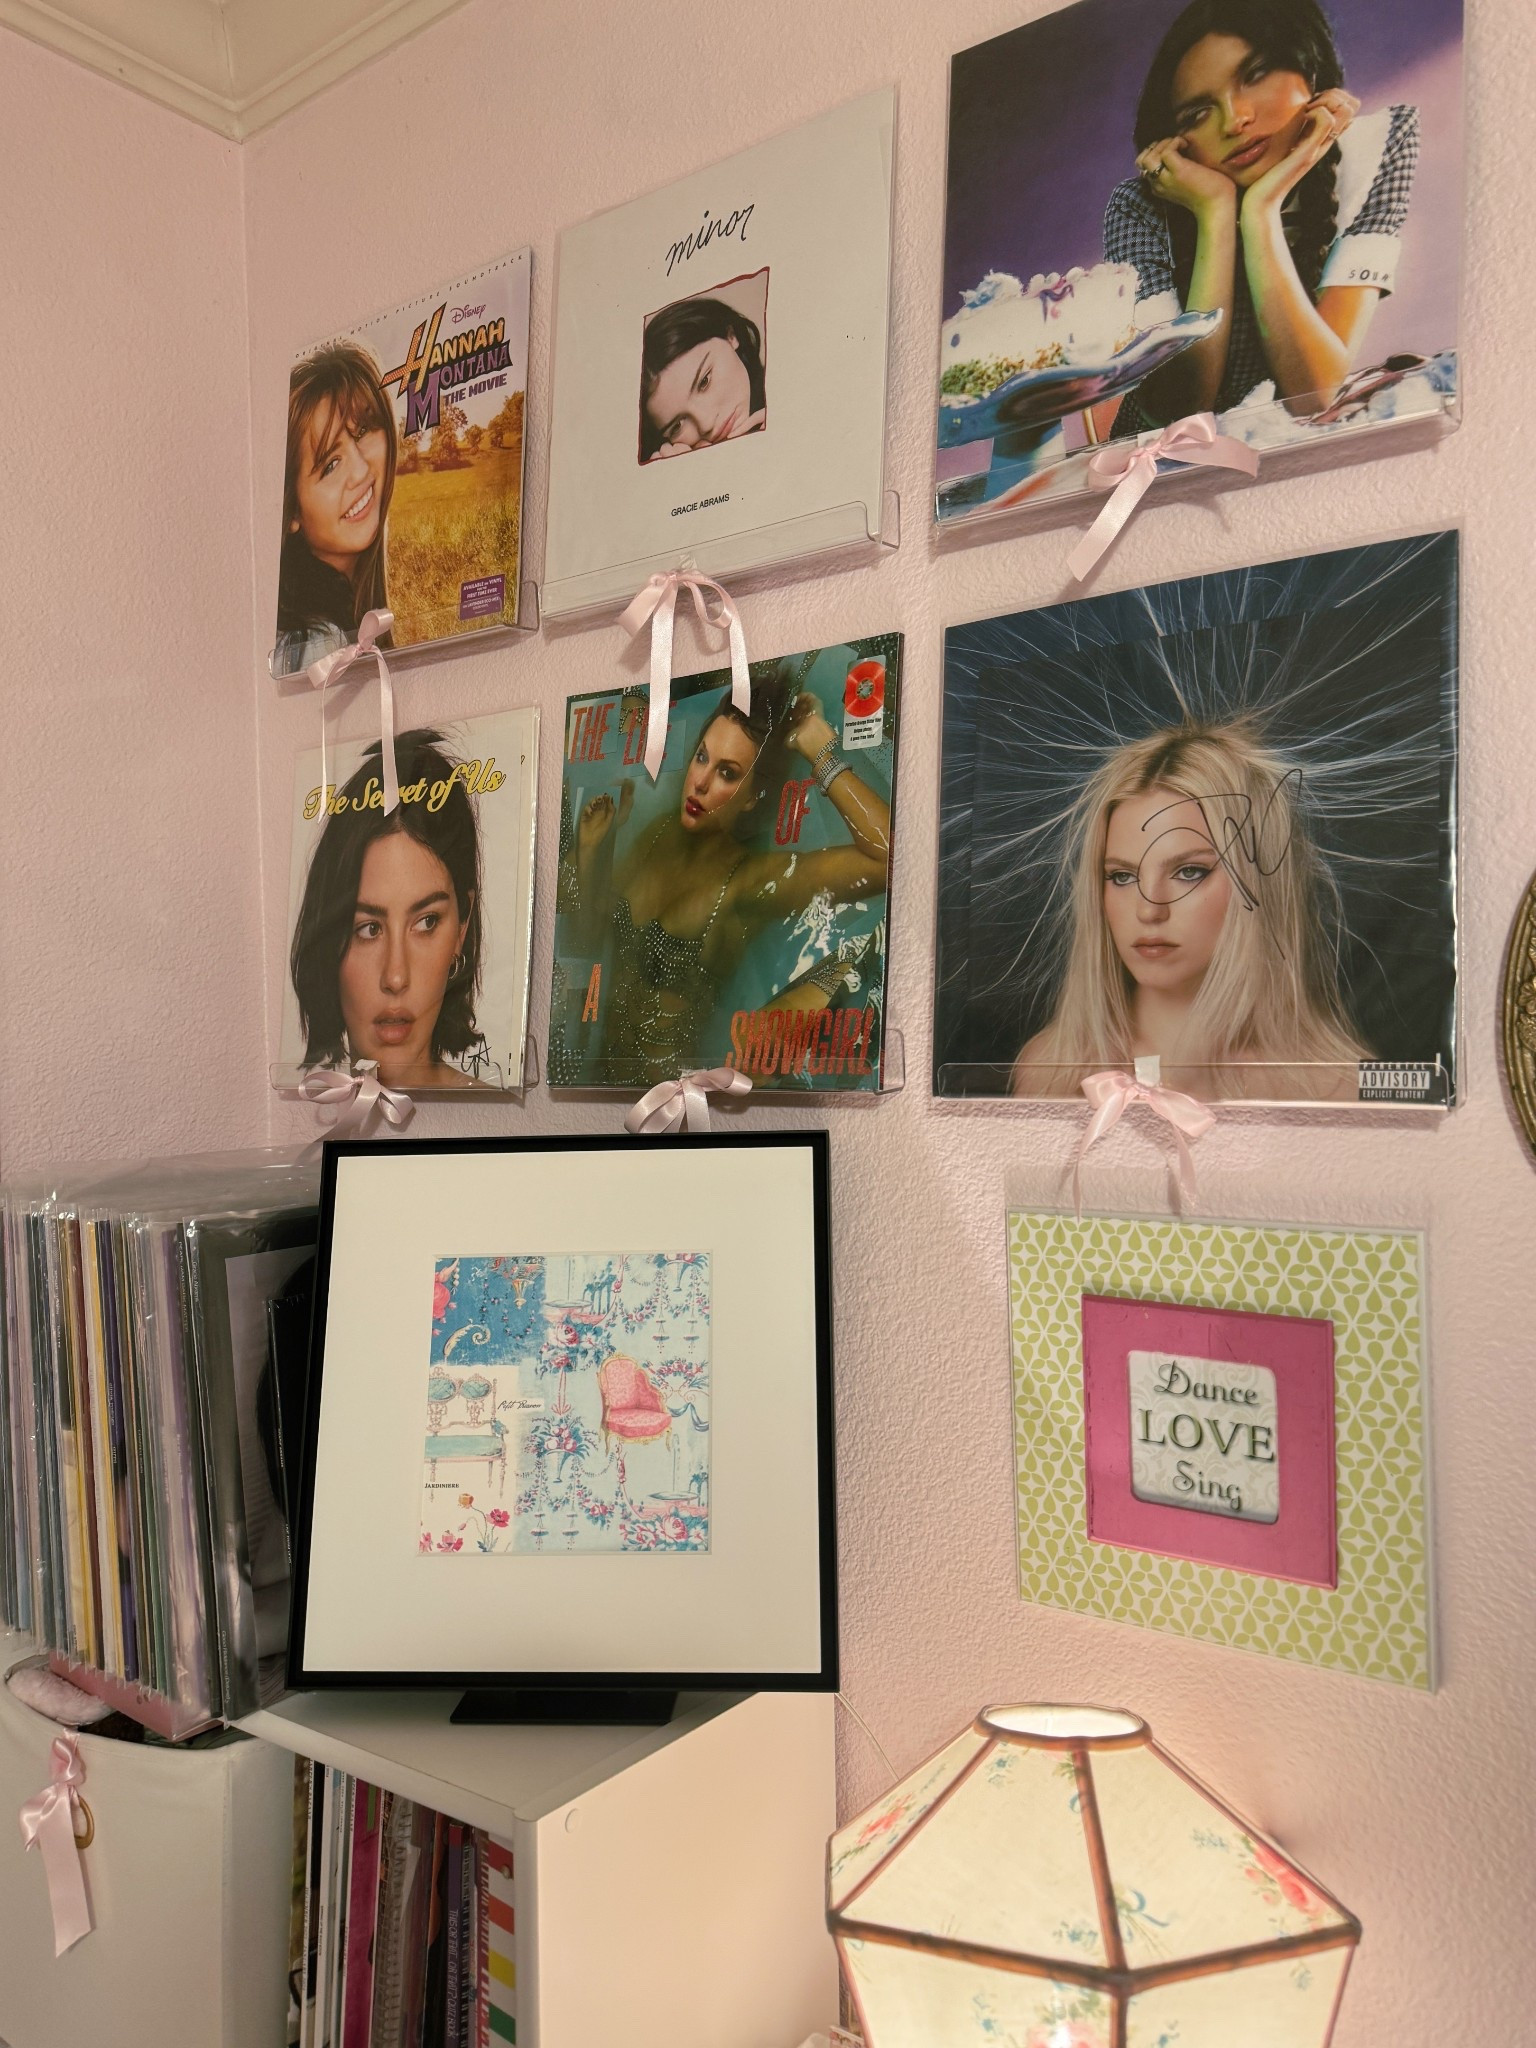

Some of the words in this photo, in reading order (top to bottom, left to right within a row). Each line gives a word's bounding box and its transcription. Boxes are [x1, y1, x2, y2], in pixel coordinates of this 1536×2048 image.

[665, 203, 755, 277] minor
[395, 291, 440, 314] PICTURE
[449, 254, 523, 292] SOUNDTRACK
[1348, 269, 1390, 282] SOUR
[379, 301, 506, 399] HANNAH
[404, 340, 512, 439] MONTANA
[444, 387, 467, 406] THE
[468, 373, 508, 396] MOVIE
[670, 502, 698, 517] GRACIE
[698, 493, 730, 509] ABRAMS
[569, 702, 616, 765] THE
[302, 784, 350, 820] The
[352, 777, 430, 812] Seret
[426, 763, 467, 813] of
[464, 757, 507, 795] Us
[774, 778, 817, 845] OF
[581, 963, 602, 1023] A
[725, 1007, 875, 1076] SHOWGIRL
[1362, 1072, 1427, 1088] ADVISORY
[1362, 1089, 1393, 1099] EXPLICIT
[1395, 1089, 1426, 1099] CONTENT
[1153, 1360, 1260, 1405] Dance
[1138, 1408, 1276, 1464] LOVE
[1172, 1460, 1242, 1513] Sing
